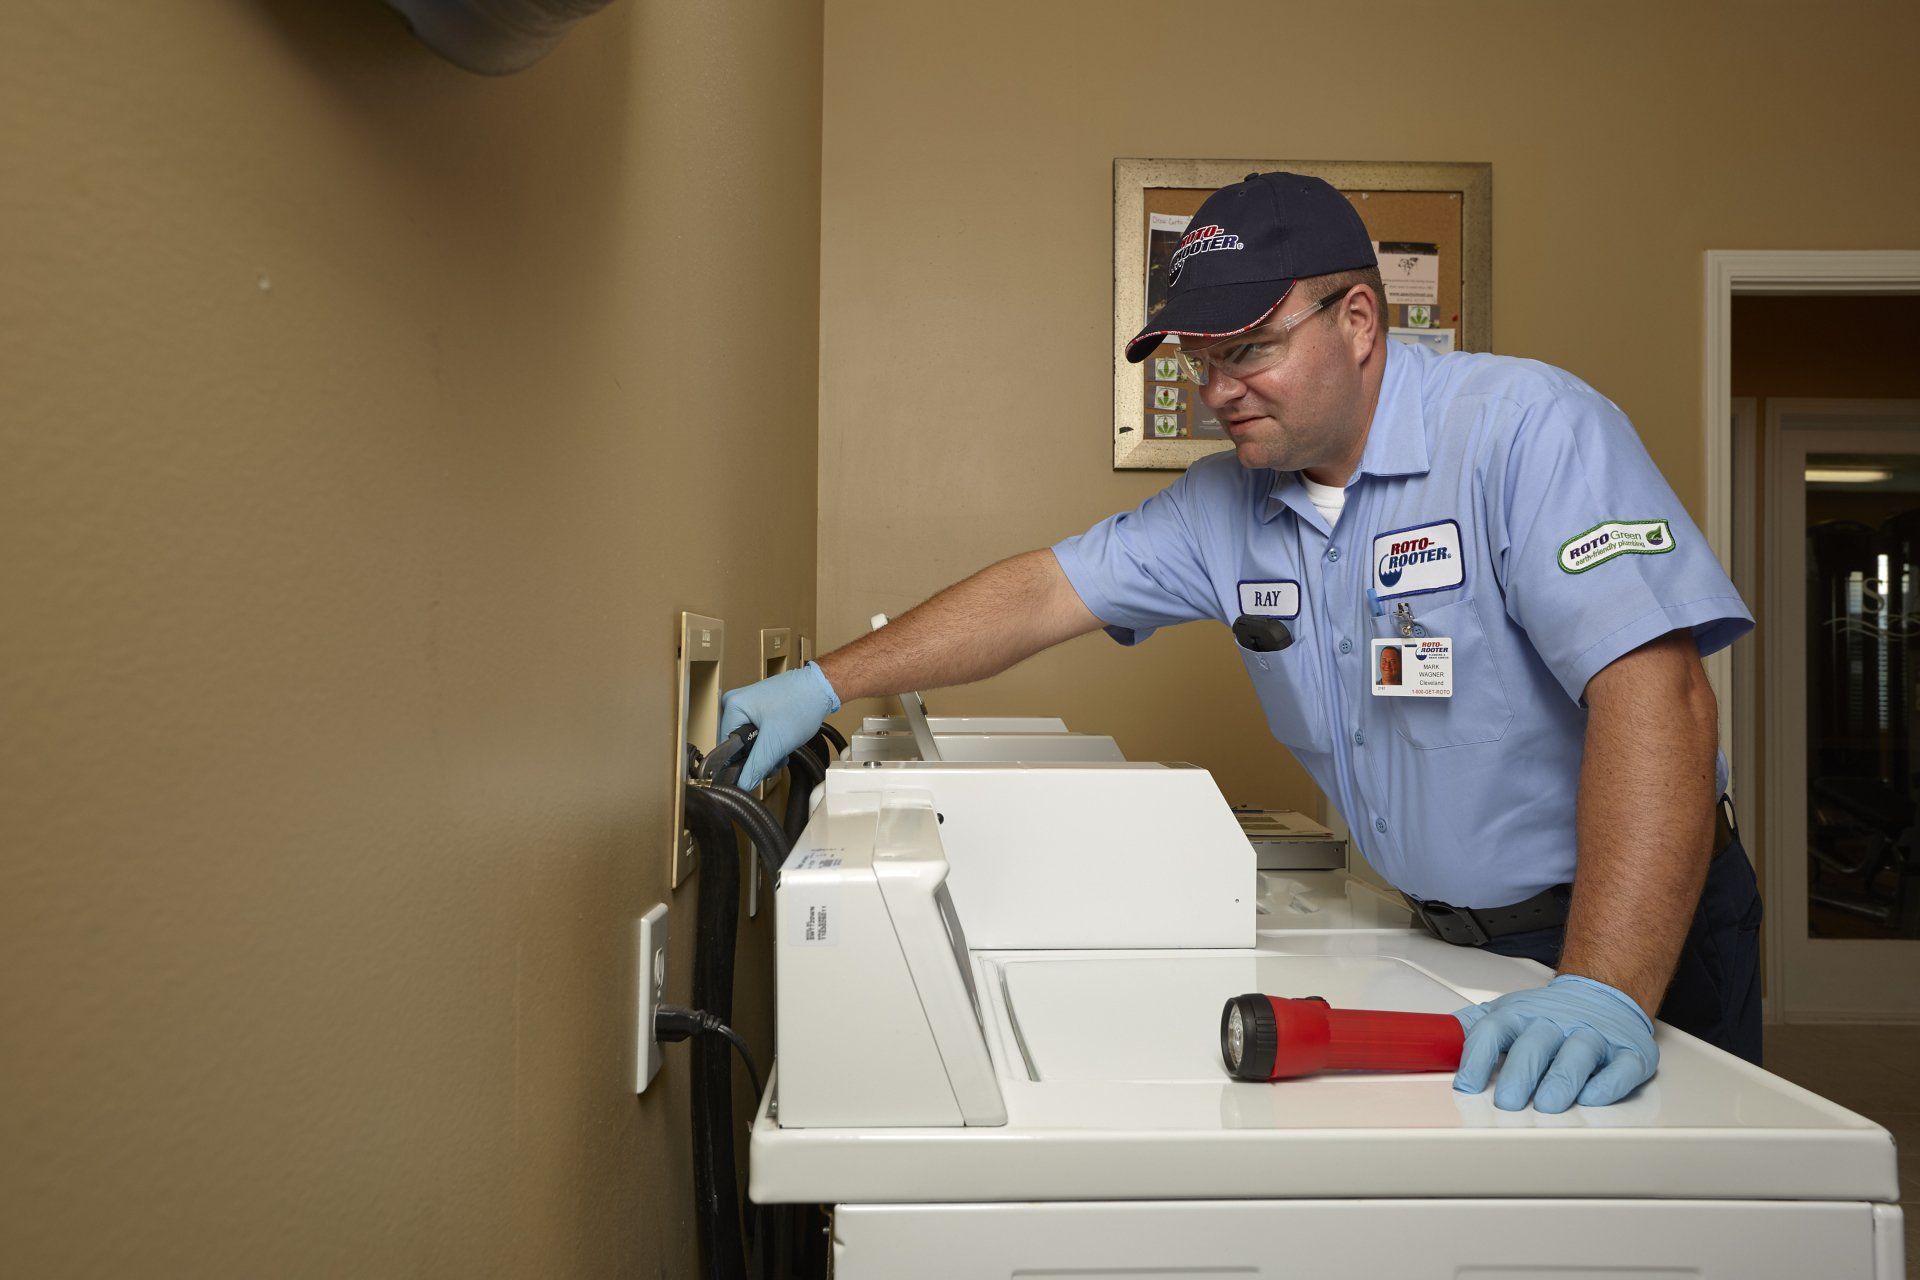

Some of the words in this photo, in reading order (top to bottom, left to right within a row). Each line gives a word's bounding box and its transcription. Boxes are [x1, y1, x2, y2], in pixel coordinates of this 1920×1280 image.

[1390, 537, 1435, 555] ROTO-
[1569, 533, 1610, 560] ROTO
[1610, 530, 1642, 541] Green
[1575, 542, 1617, 566] earth-friendly
[1617, 540, 1646, 548] plumbing
[1254, 591, 1282, 607] RAY
